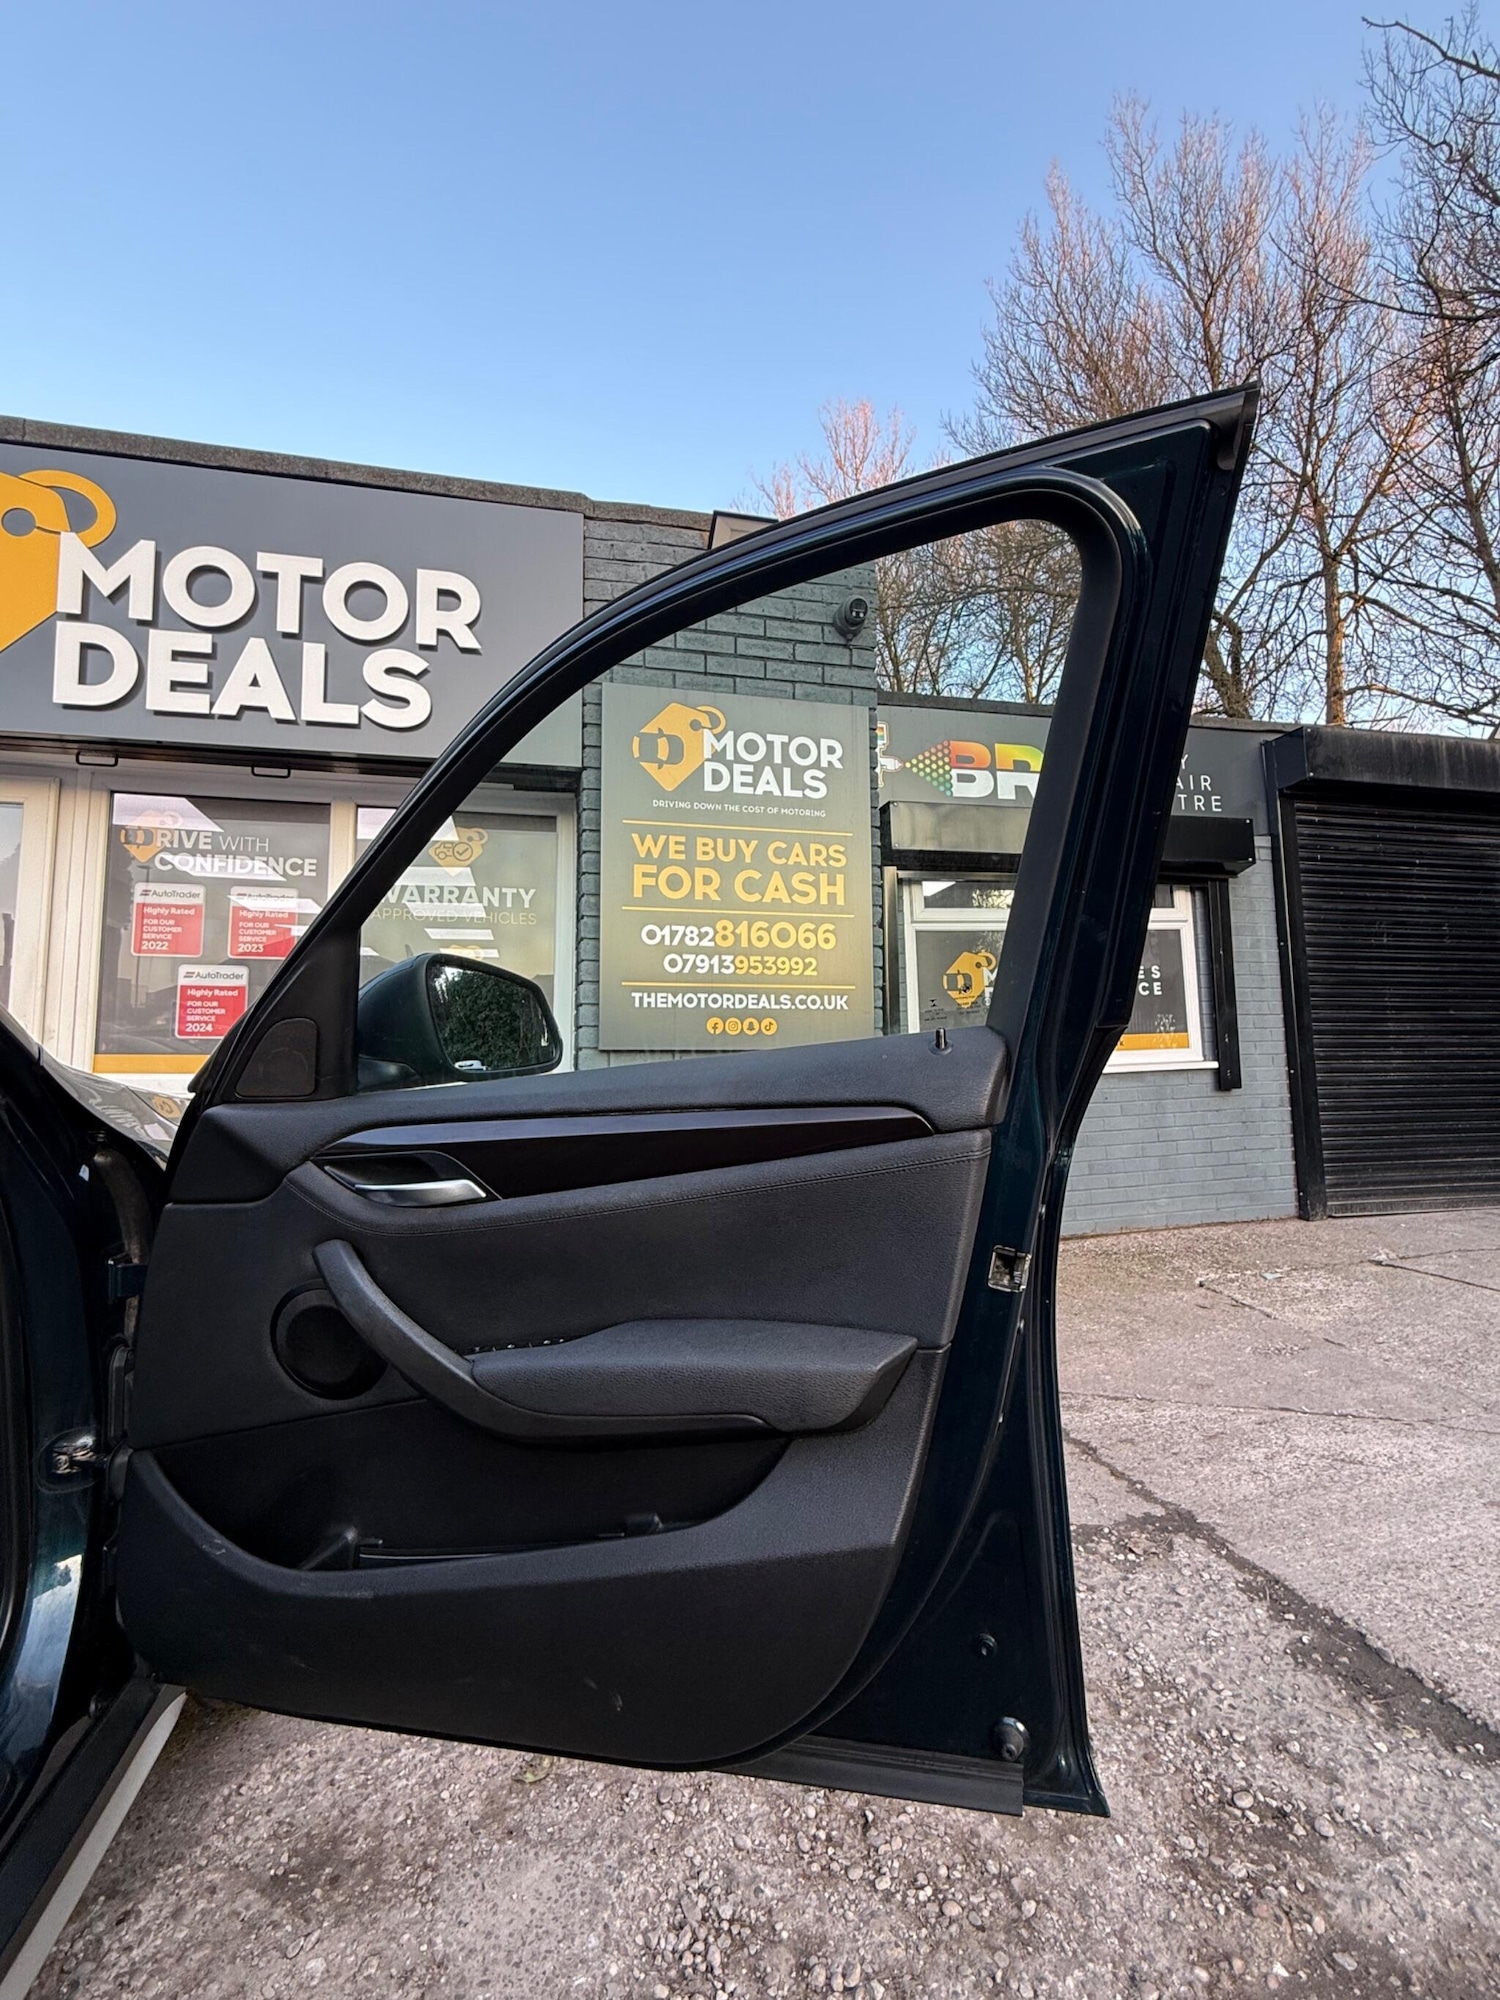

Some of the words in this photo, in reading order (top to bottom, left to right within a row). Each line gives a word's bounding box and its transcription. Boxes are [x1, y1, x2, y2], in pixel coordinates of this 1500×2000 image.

[57, 531, 482, 652] MOTOR
[53, 621, 433, 730] DEALS
[703, 729, 843, 768] MOTOR
[704, 761, 827, 799] DEALS
[653, 799, 691, 809] DRIVING
[694, 802, 722, 811] DOWN
[724, 804, 740, 812] THE
[742, 805, 765, 814] COST
[767, 806, 779, 814] OF
[781, 807, 826, 817] MOTORING
[219, 836, 269, 852] WITH
[631, 833, 686, 860] WE
[696, 836, 758, 863] BUY
[767, 841, 847, 868] CARS
[154, 852, 317, 877] CONFIDENCE
[633, 864, 721, 901] FOR
[734, 869, 845, 905] CASH
[151, 889, 200, 899] AutoTrader
[143, 906, 169, 915] Highly
[170, 907, 195, 915] Rated
[239, 909, 264, 918] Highly
[370, 907, 457, 922] APPROVED
[464, 911, 537, 925] VEHICLES
[641, 919, 837, 950] 01782816066
[141, 941, 169, 950] 2022
[237, 944, 264, 953] 2023
[663, 953, 817, 976] 07913953992
[195, 971, 244, 980] AutoTrader
[187, 989, 213, 997] Highly
[214, 989, 239, 997] Rated
[631, 992, 848, 1010] THEMOTORDEALS.CO.UK
[185, 1023, 213, 1032] 2024
